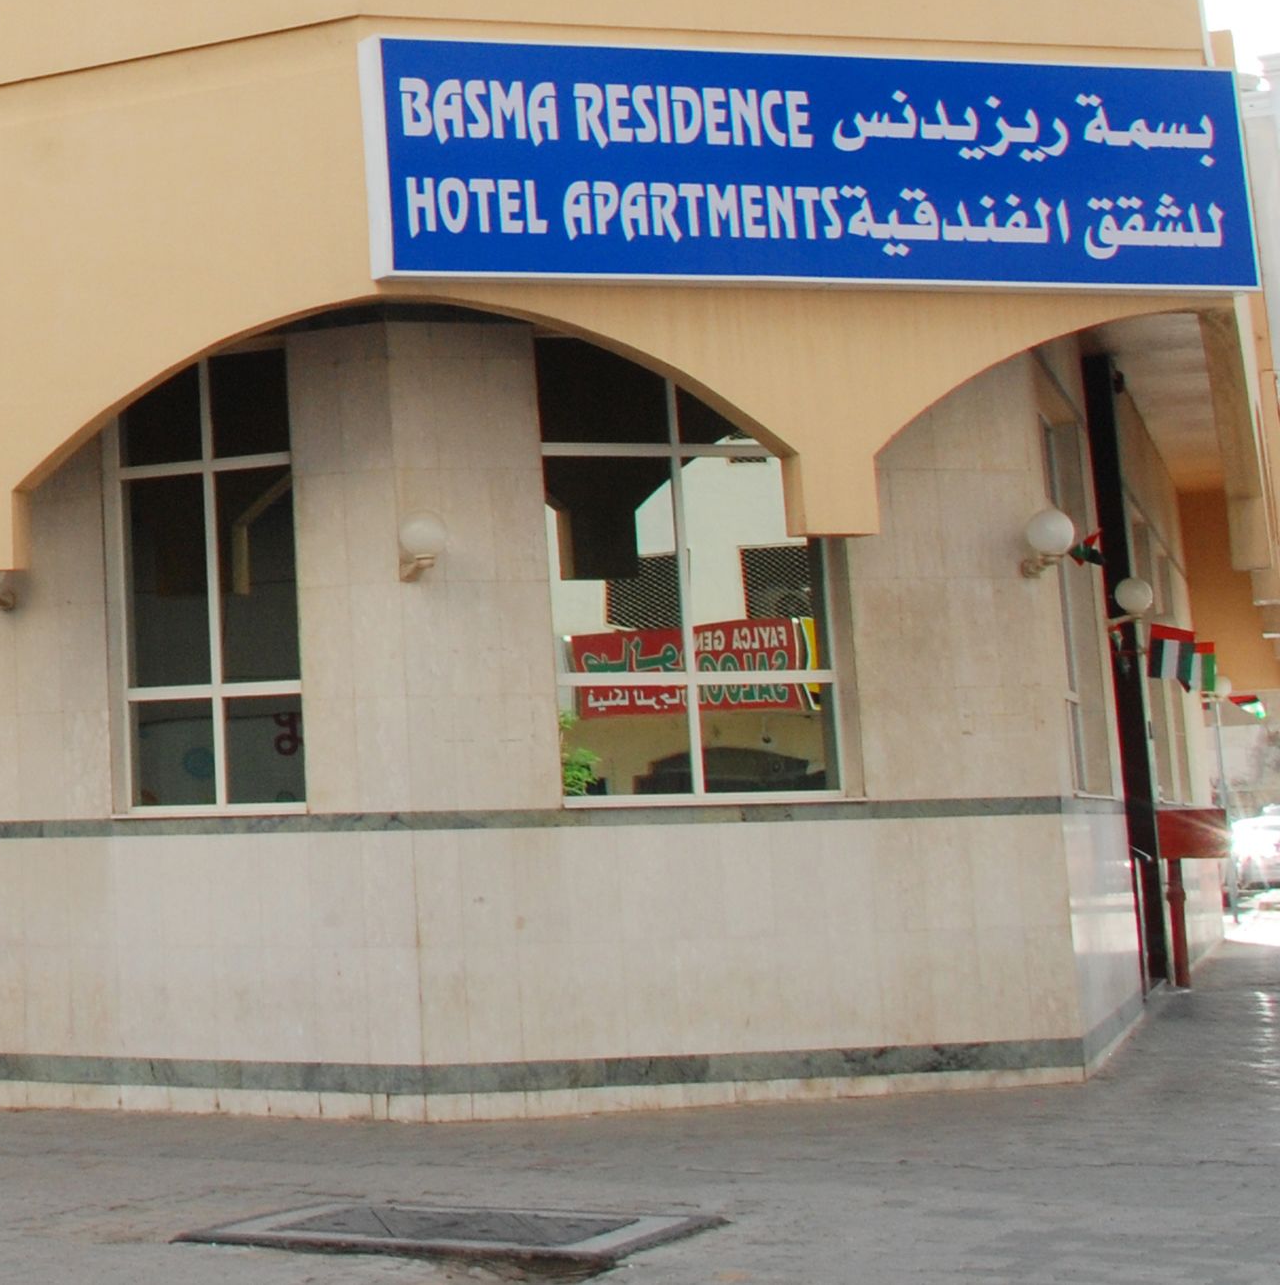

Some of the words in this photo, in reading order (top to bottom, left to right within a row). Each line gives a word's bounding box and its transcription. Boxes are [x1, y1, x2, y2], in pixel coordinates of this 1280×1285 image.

[399, 77, 559, 146] BASMA
[573, 82, 813, 148] RESIDENCE
[832, 89, 1070, 162] ريزيدنس
[1075, 93, 1215, 167] بسمة
[405, 176, 548, 238] HOTEL
[563, 180, 842, 242] APARTMENTS
[840, 185, 1070, 257] الفندقية
[1084, 193, 1224, 260] للشقق
